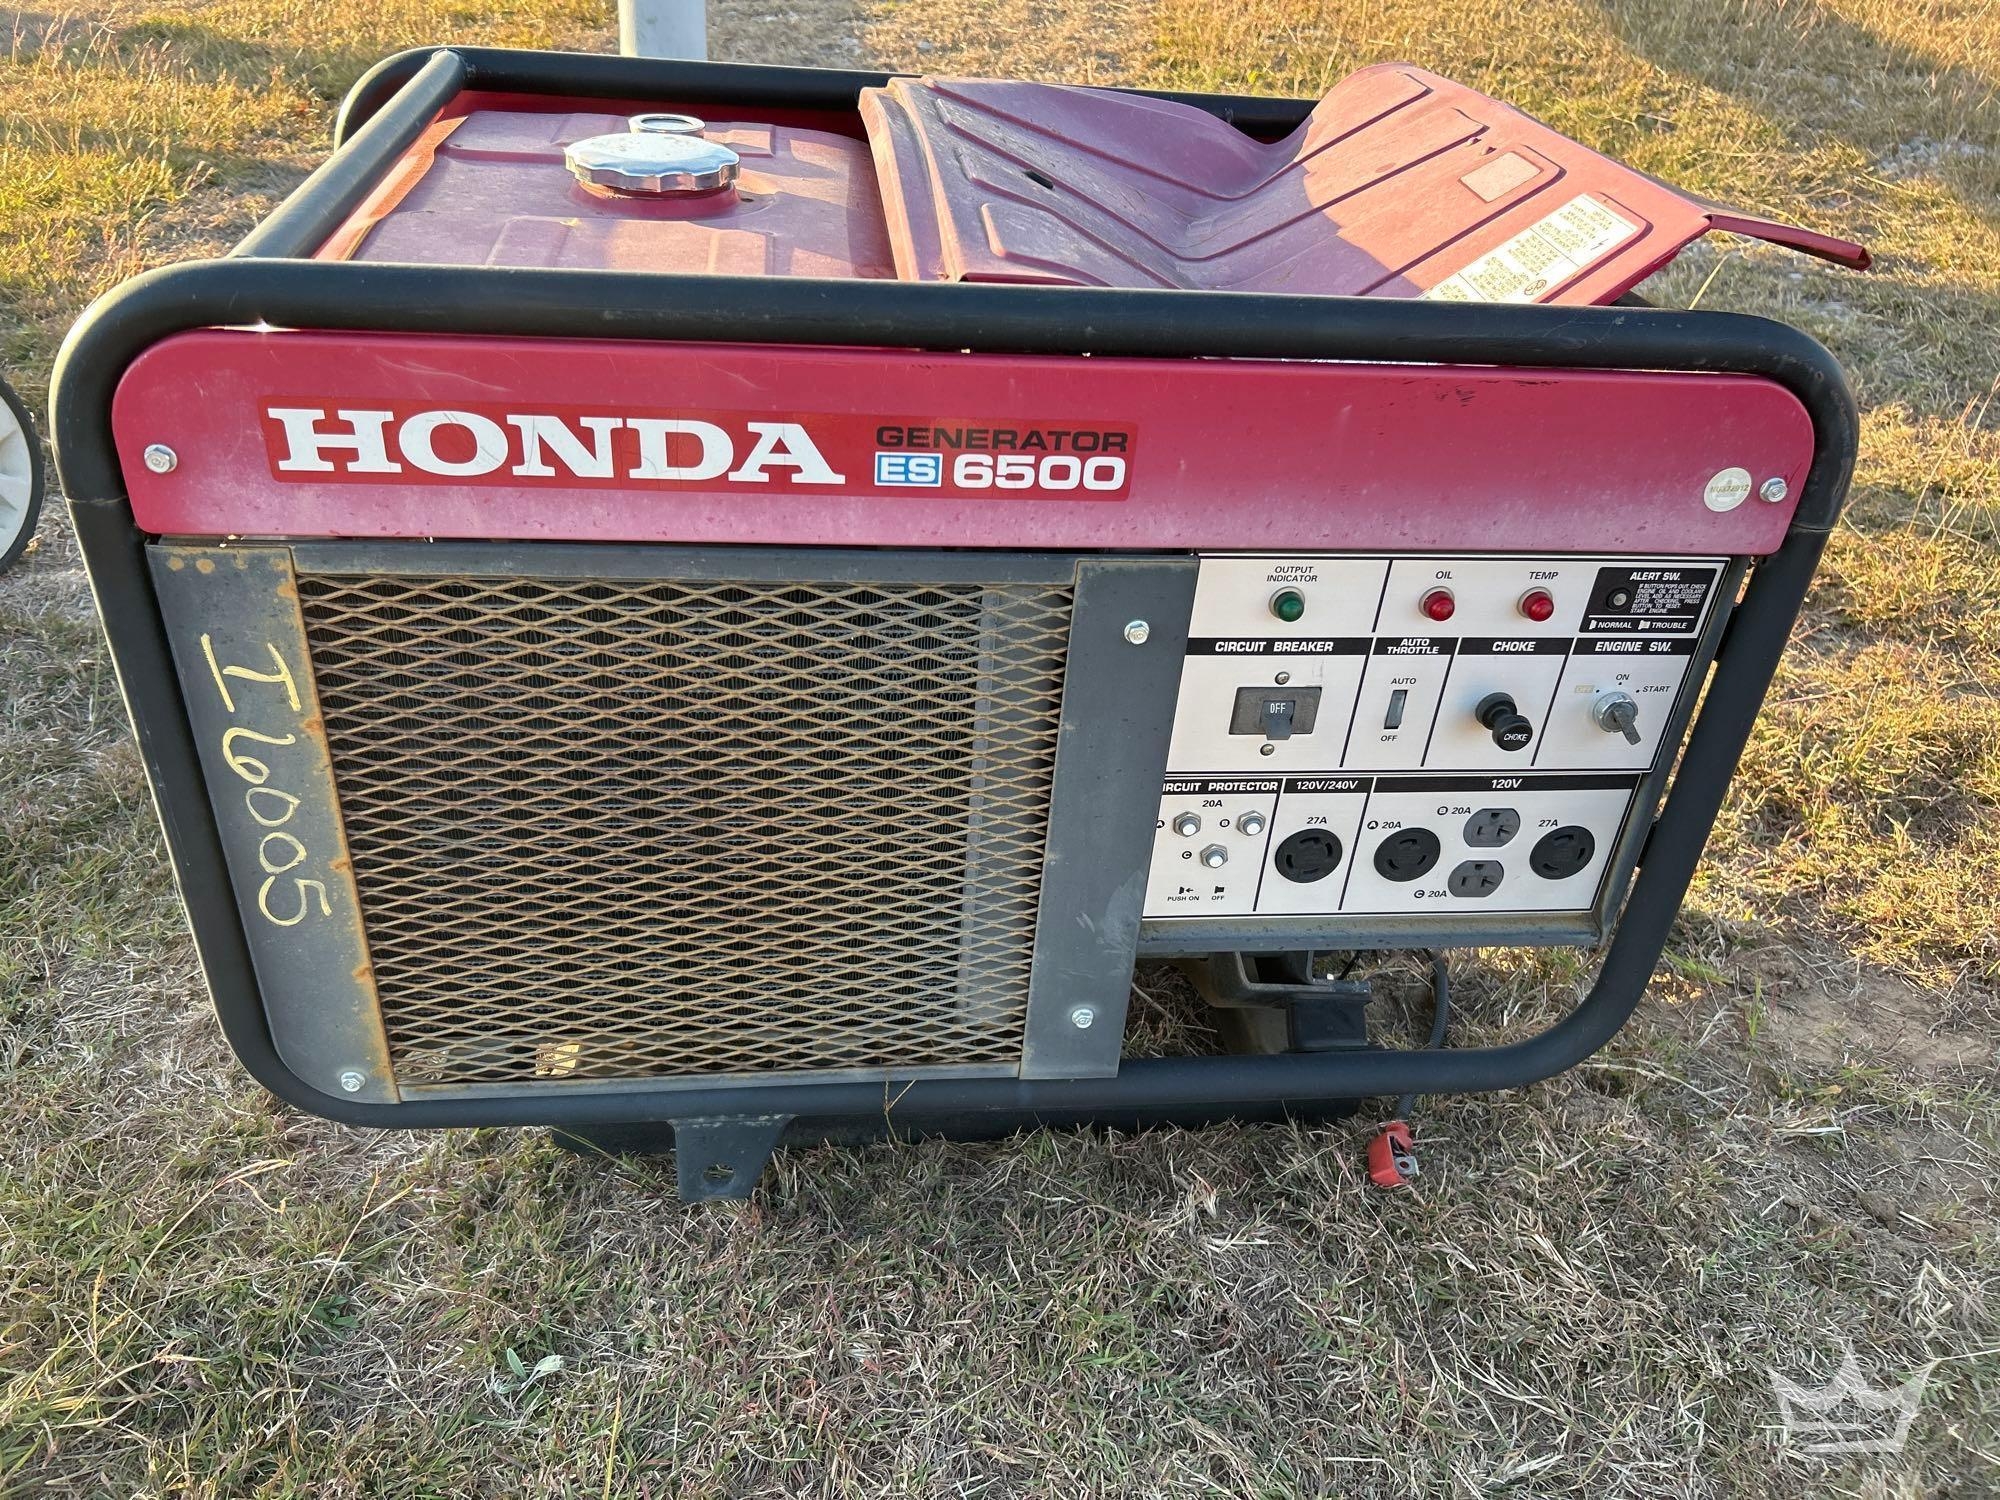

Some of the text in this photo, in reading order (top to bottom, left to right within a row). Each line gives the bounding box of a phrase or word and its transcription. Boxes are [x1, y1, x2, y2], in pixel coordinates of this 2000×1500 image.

[876, 426, 1129, 454] GENERATOR
[267, 407, 846, 486] HONDA
[880, 454, 1126, 491] ES 6500
[1274, 566, 1314, 574] OUTPUT
[1266, 574, 1318, 582] INDICATOR
[1435, 571, 1453, 580] OIL
[1529, 571, 1559, 580] TEMP
[1630, 572, 1681, 580] ALERT SW.
[1215, 641, 1334, 652] CIRCUIT BREAKER
[1400, 638, 1430, 646] AUTO
[1492, 641, 1536, 652] CHOKE
[1594, 641, 1672, 652] ENGINE SW.
[1387, 646, 1440, 654] THROTTLE
[1269, 702, 1286, 714] OFF
[1503, 732, 1529, 742] CHOKE
[1162, 782, 1278, 792] IRCUIT PROTECTOR
[1296, 780, 1359, 790] 120V/240V
[1490, 779, 1523, 788] 120V
[1202, 800, 1223, 808] 20A
[1451, 806, 1472, 815] 20A
[1306, 816, 1327, 825] 27A
[1381, 821, 1402, 829] 20A
[1538, 819, 1558, 827] 27A
